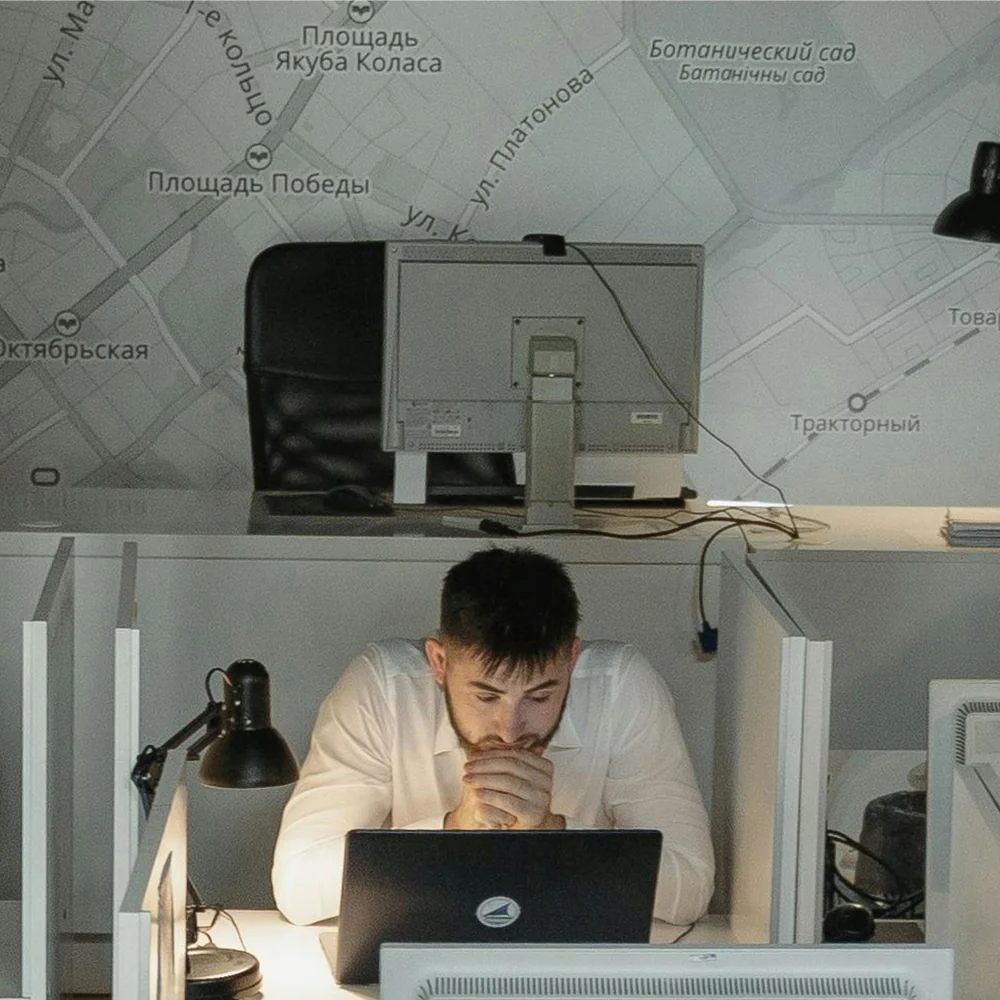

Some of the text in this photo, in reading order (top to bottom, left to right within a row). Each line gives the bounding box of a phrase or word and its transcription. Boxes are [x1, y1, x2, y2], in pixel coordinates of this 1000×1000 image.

[302, 25, 418, 50] Площадь
[650, 39, 856, 62] Ботанический сад
[42, 52, 73, 88] ул.
[276, 51, 442, 77] Якуба Коласа
[679, 64, 826, 83] Батанічны сад
[218, 29, 272, 126] кольцо
[470, 69, 594, 211] ул. Платонова
[150, 171, 369, 198] Площадь Победы
[400, 205, 437, 236] ул.
[947, 307, 1000, 331] Това
[790, 414, 921, 437] Тракторный
